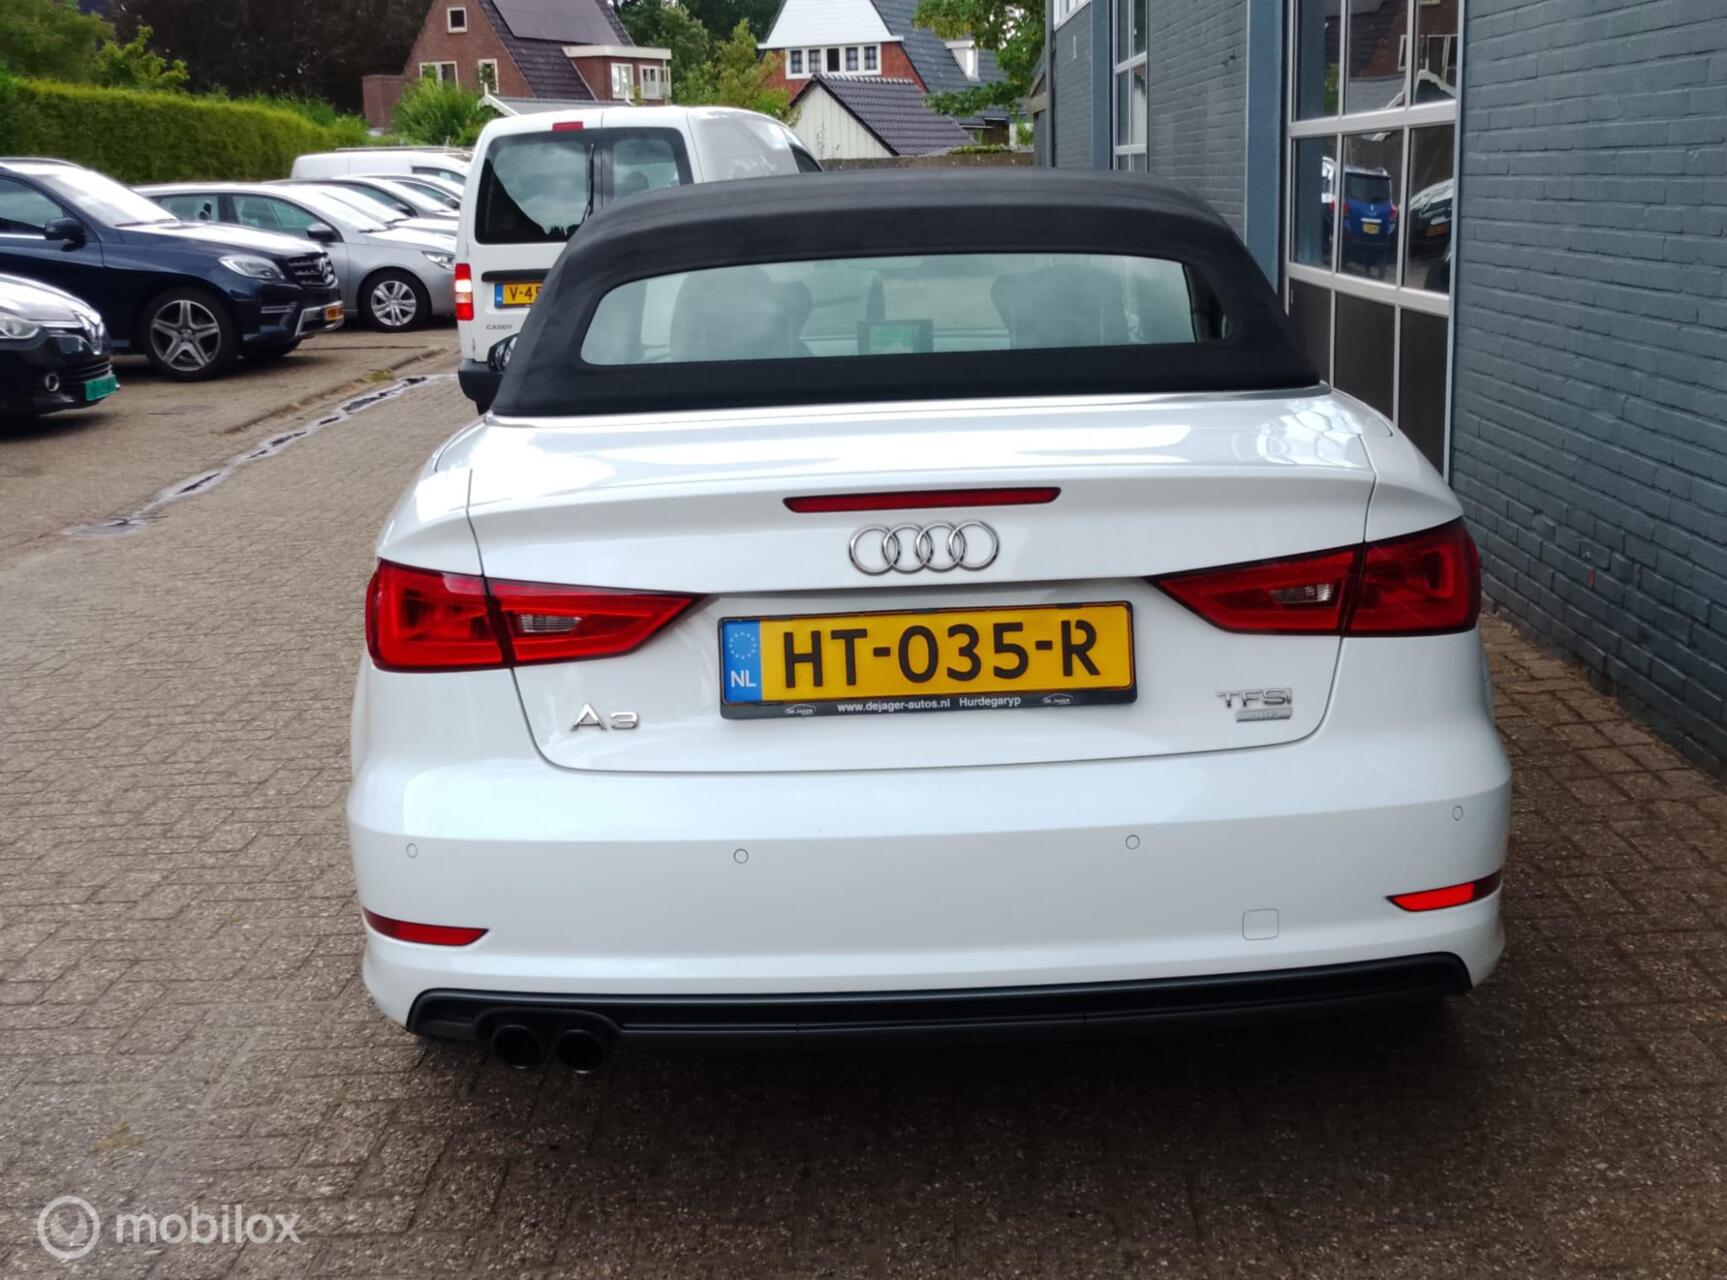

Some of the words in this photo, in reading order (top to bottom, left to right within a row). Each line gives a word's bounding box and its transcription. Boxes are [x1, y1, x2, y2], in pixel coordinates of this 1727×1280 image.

[783, 619, 1101, 689] HT-035-R
[730, 669, 757, 688] NL
[837, 699, 950, 713] www.dejager-autos.nl
[959, 696, 1021, 708] Hurdegaryp
[1216, 688, 1292, 708] TFSI
[570, 703, 640, 732] A3
